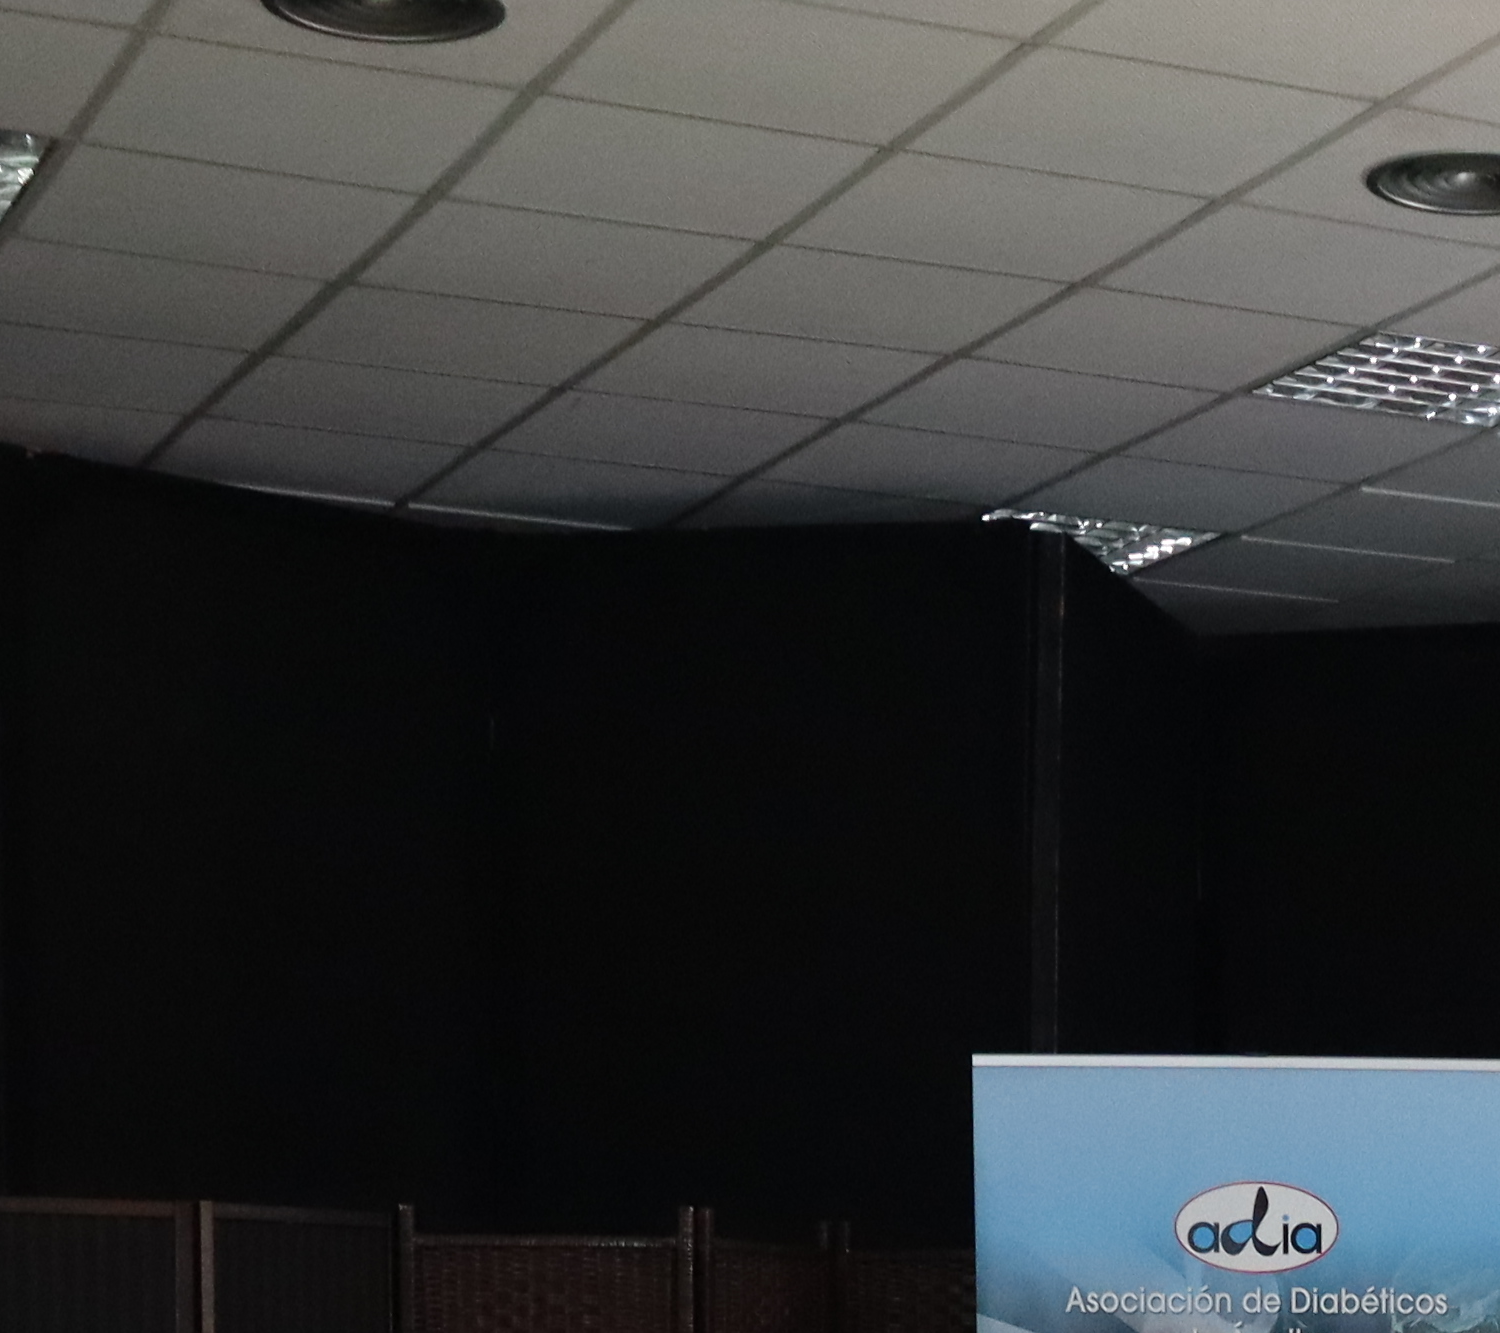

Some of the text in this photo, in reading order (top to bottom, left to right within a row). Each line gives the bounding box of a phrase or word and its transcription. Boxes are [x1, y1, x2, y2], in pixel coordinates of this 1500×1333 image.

[1187, 1186, 1323, 1257] adia
[1065, 1284, 1449, 1316] Asociación de Diabéticos
